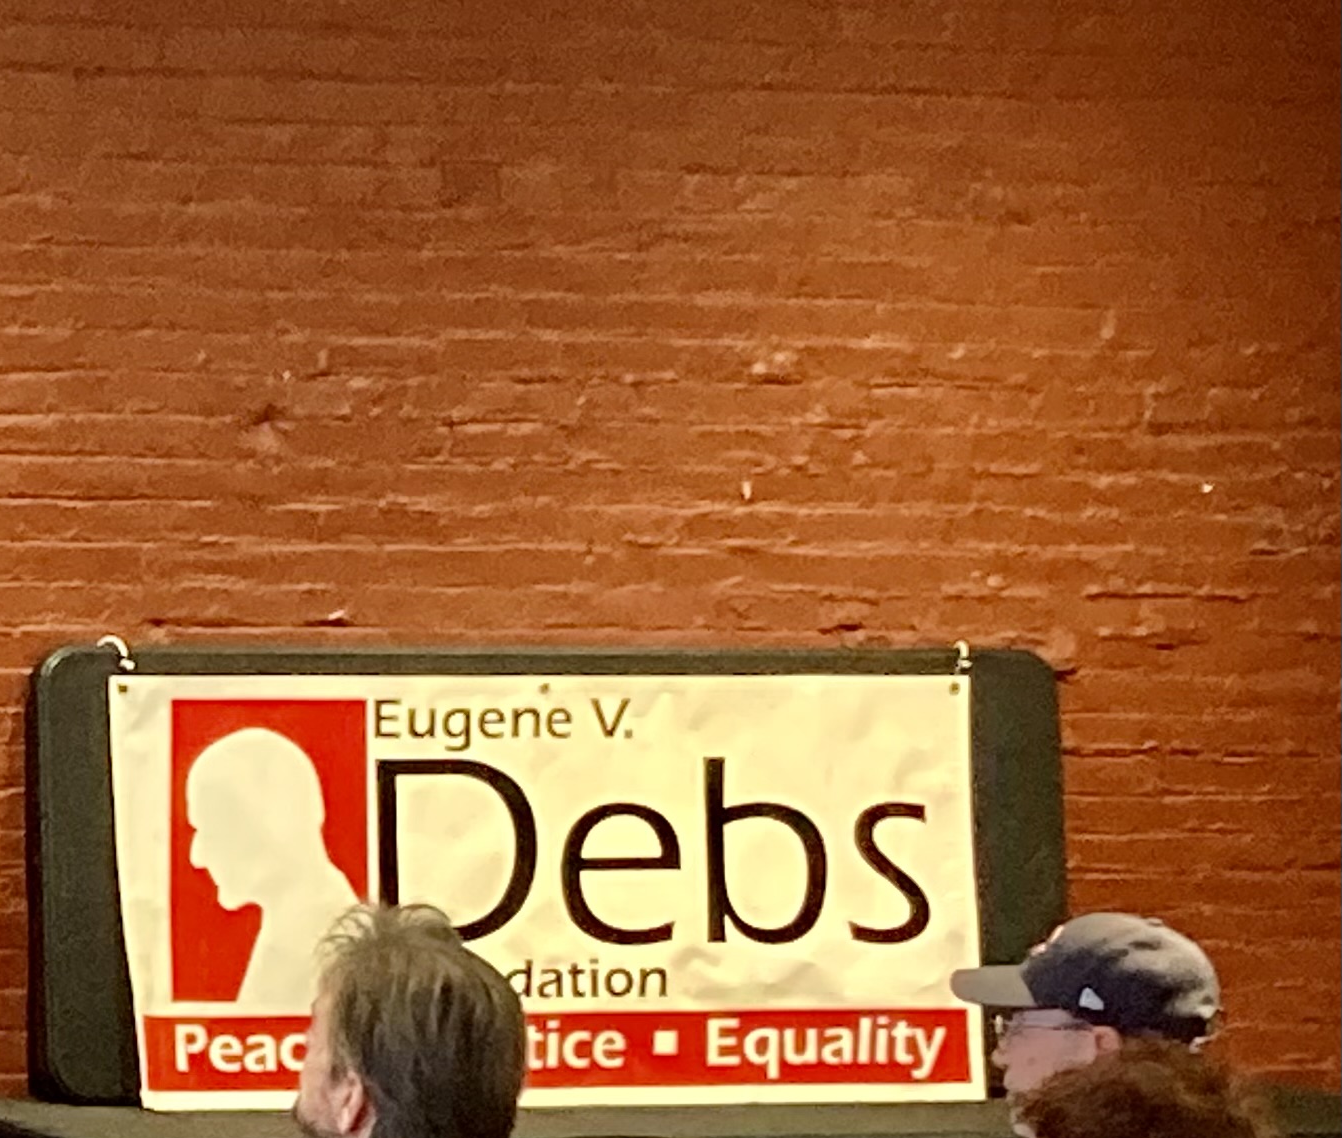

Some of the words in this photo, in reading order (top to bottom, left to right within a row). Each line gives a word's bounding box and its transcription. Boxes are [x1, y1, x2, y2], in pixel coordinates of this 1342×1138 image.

[374, 698, 573, 752] Eugene
[590, 697, 634, 740] V.
[375, 756, 931, 945] Debs
[505, 958, 669, 999] dation
[174, 1023, 309, 1073] Peac
[526, 1019, 627, 1070] tice
[706, 1015, 947, 1080] Equality
